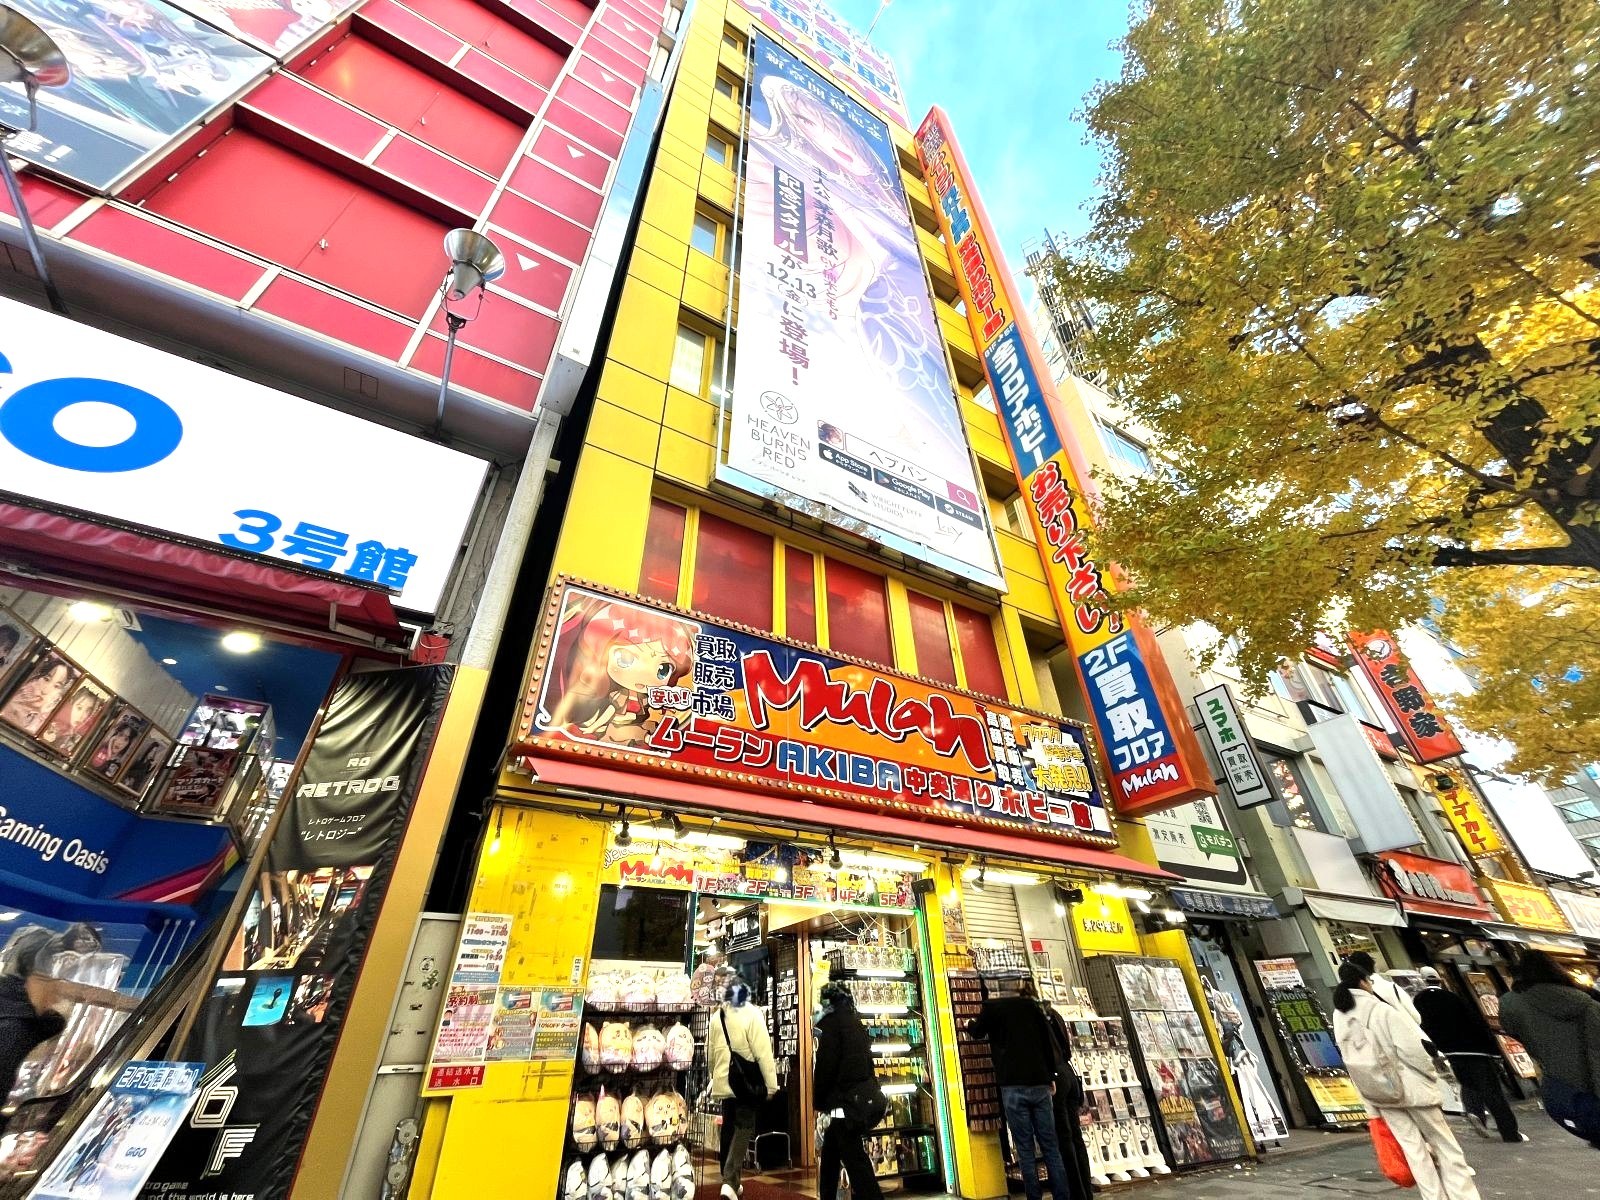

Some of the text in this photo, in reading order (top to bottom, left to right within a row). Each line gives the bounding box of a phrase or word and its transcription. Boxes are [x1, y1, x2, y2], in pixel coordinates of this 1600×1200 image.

[766, 262, 817, 299] 12.13
[0, 351, 183, 473] O
[993, 339, 1047, 468] 全フロアホビー
[747, 414, 811, 450] HEAVEN
[752, 428, 807, 461] BURNS
[762, 446, 795, 469] RED
[869, 450, 928, 482] ヘブバン
[891, 477, 931, 501] Google Play
[217, 508, 419, 588] 3号館
[695, 634, 737, 662] 買取
[693, 661, 735, 690] 販売
[650, 687, 690, 707] 安い!
[691, 691, 735, 721] 市場
[1085, 634, 1166, 772] 2F 買取 フロア
[742, 650, 996, 774] Mulan
[1206, 697, 1236, 745] スマホ
[1020, 724, 1062, 743] ワクワク
[648, 716, 1095, 833] ムーラン AKIBA 中央通りホビー館
[1226, 752, 1248, 768] 買取
[1031, 763, 1093, 793] 大発見!!
[1121, 762, 1180, 800] Mulan
[1233, 768, 1255, 785] 販売
[307, 814, 366, 826] レトロゲームフロア
[63, 838, 109, 874] Oasis
[696, 876, 717, 891] 1F
[745, 880, 768, 895] 2F
[793, 885, 815, 900] 3F
[838, 889, 857, 902] 4F
[879, 893, 898, 907] 5F
[433, 1076, 479, 1088] 送水口
